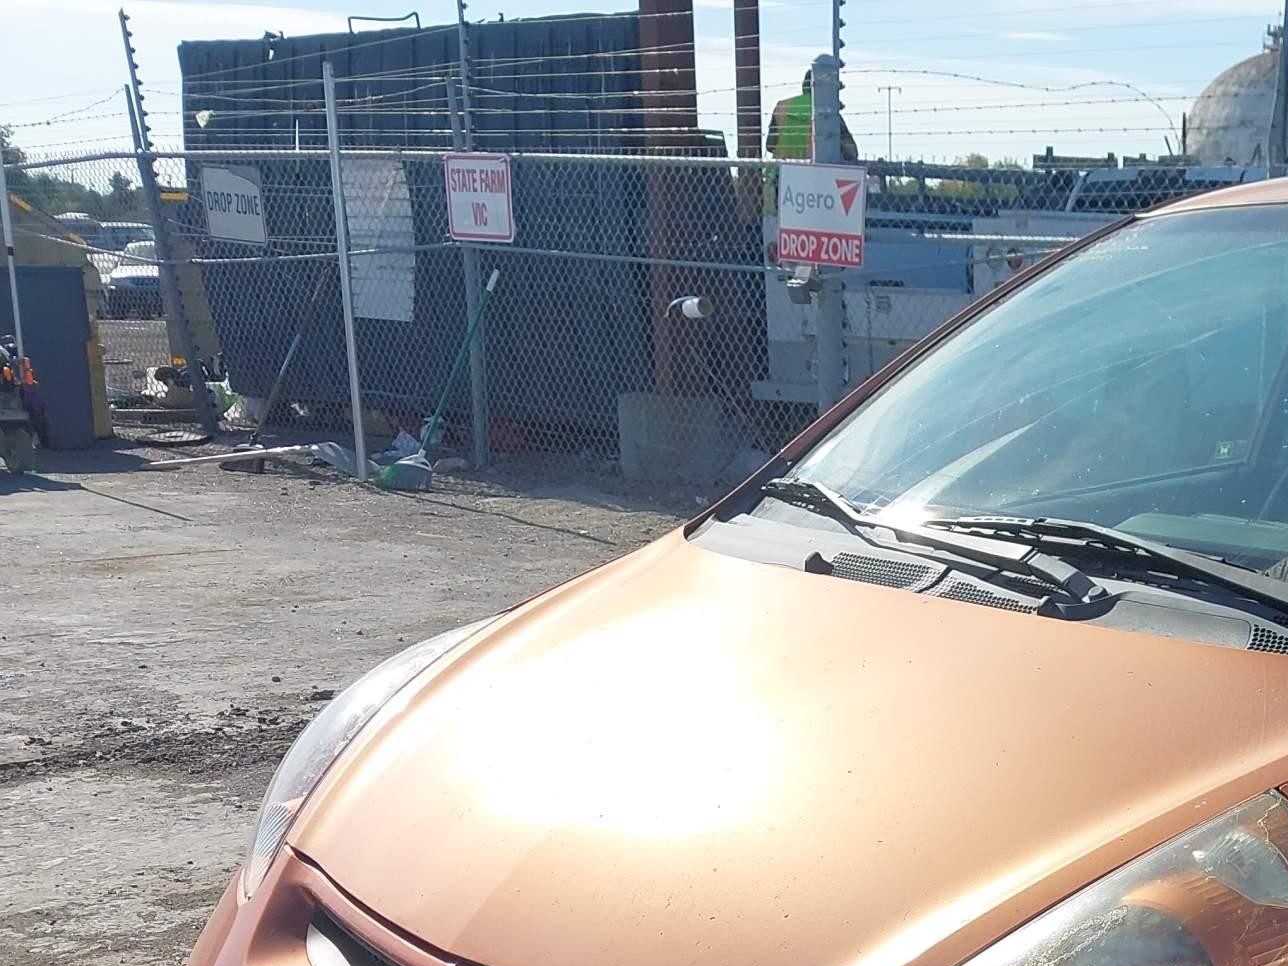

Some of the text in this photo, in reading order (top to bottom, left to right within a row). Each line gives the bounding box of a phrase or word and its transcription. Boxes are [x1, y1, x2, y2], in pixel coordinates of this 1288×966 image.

[450, 168, 506, 193] STATE FARM
[206, 191, 261, 216] DROP ZONE
[782, 184, 835, 215] Agero
[471, 202, 488, 227] VIC
[780, 233, 861, 263] DROP ZONE
